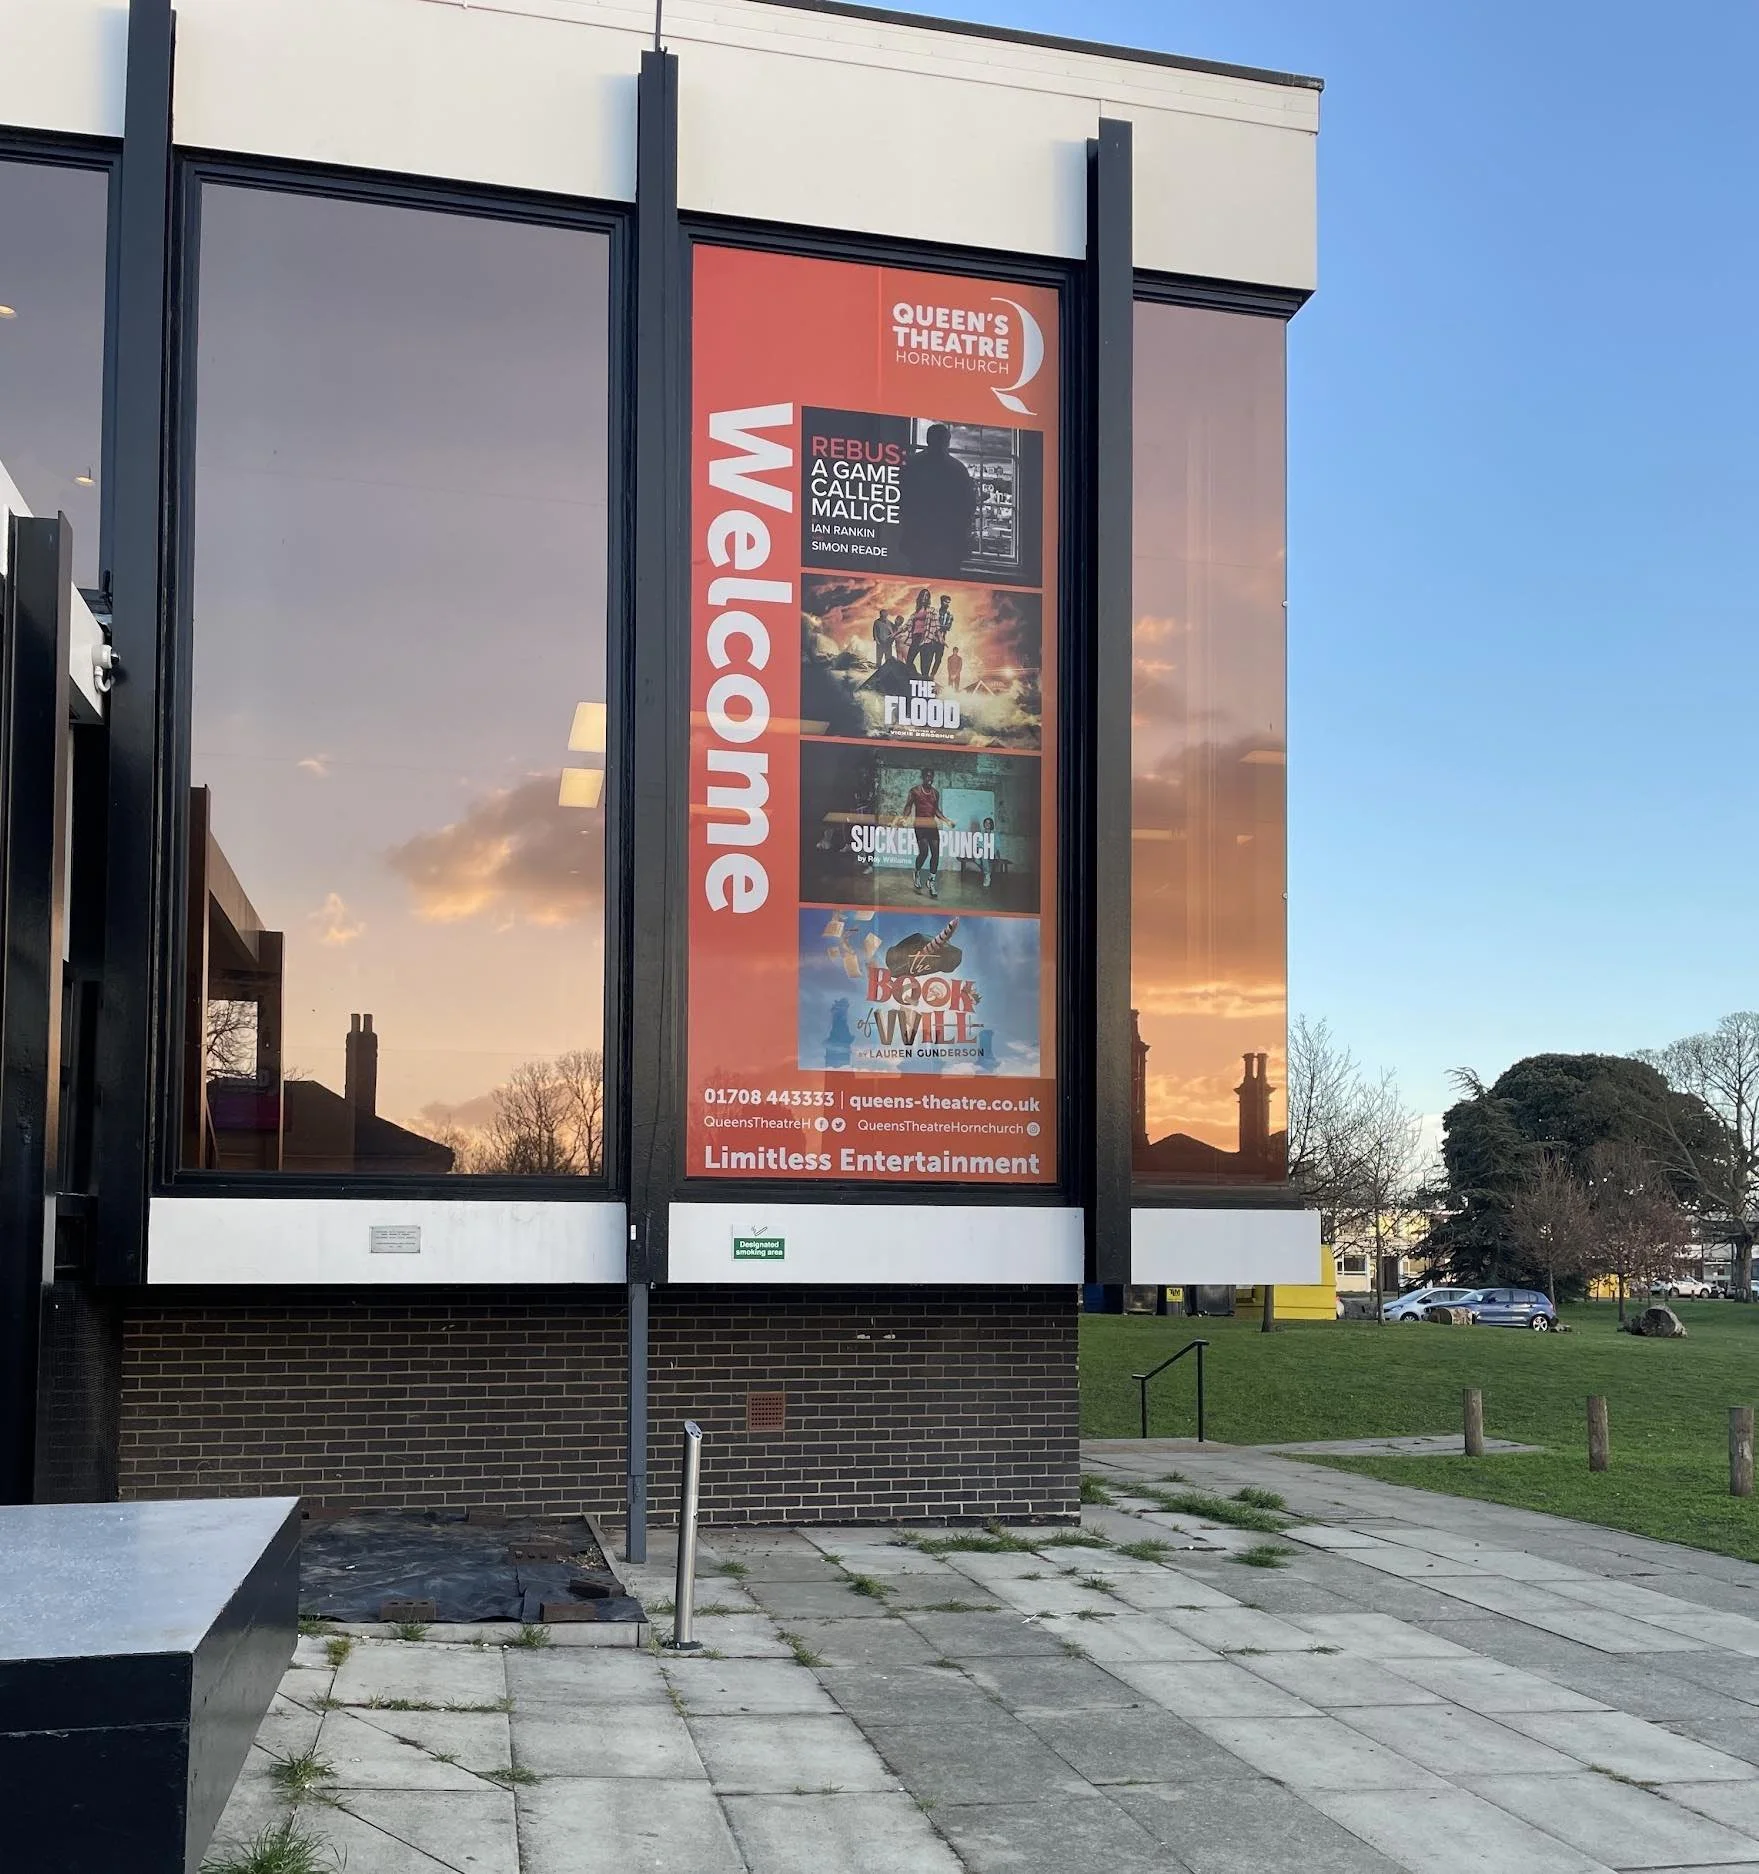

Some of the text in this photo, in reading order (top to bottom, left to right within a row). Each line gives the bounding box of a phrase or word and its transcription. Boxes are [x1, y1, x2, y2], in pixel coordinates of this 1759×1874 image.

[892, 302, 1009, 335] QUEEN'S
[892, 327, 1009, 359] THEATRE
[896, 351, 1009, 375] HORNCHURCH
[812, 436, 907, 466] REBUS:
[811, 459, 900, 485] A GAME
[811, 478, 901, 503] CALLED
[812, 498, 900, 524] MALICE
[811, 523, 830, 534] IAN
[833, 526, 875, 538] RANKIN
[811, 541, 888, 557] SIMON READE
[705, 402, 793, 914] Welcome
[909, 680, 937, 698] THE
[884, 696, 960, 729] FLOOD
[851, 825, 994, 860] SUCKER PUNCH
[857, 855, 866, 864] by
[908, 950, 940, 974] the
[866, 966, 977, 1013] BOOK
[857, 1007, 977, 1046] of WILL
[870, 1049, 912, 1058] LAUREN
[917, 1049, 984, 1058] GUNDERSON
[704, 1088, 1040, 1112] 01708 443333 queens-theatre.co.uk
[704, 1115, 1024, 1135] QueensTheatreH QueensTheatreHornchurch
[705, 1145, 1040, 1175] Limitless Entertainment
[735, 1249, 766, 1257] smoking
[739, 1241, 779, 1249] Designated
